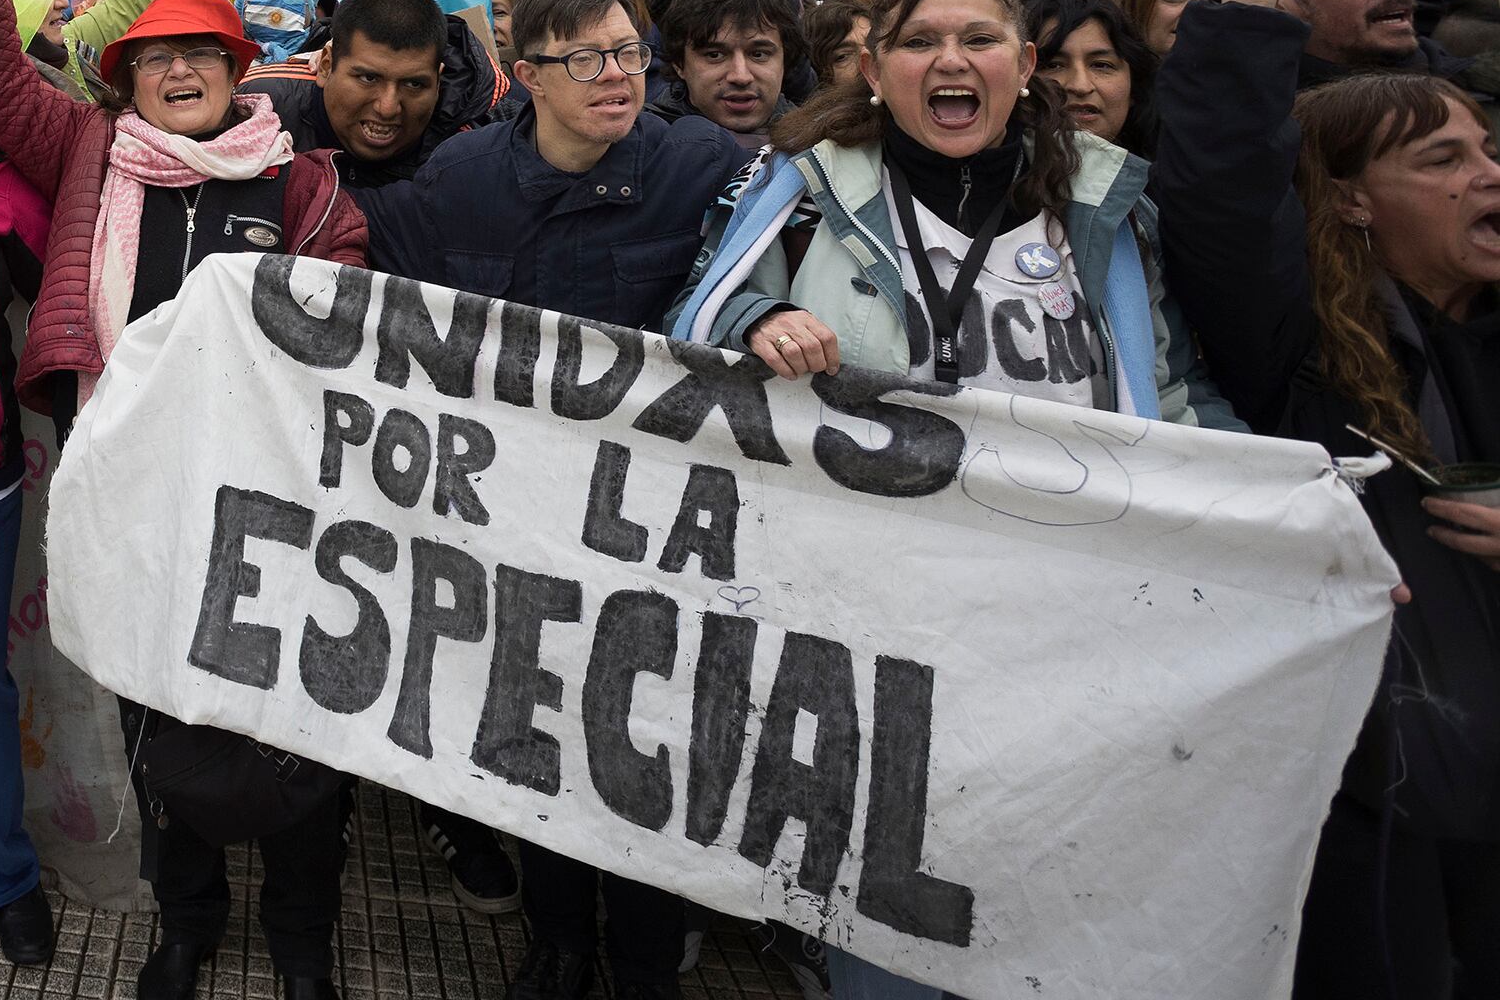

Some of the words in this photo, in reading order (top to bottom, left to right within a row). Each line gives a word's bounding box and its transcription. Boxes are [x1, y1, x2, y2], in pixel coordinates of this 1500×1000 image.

[251, 254, 967, 498] UNIDXS
[319, 389, 496, 527] POR
[581, 439, 739, 582] LA
[187, 484, 976, 948] ESPECIAL
